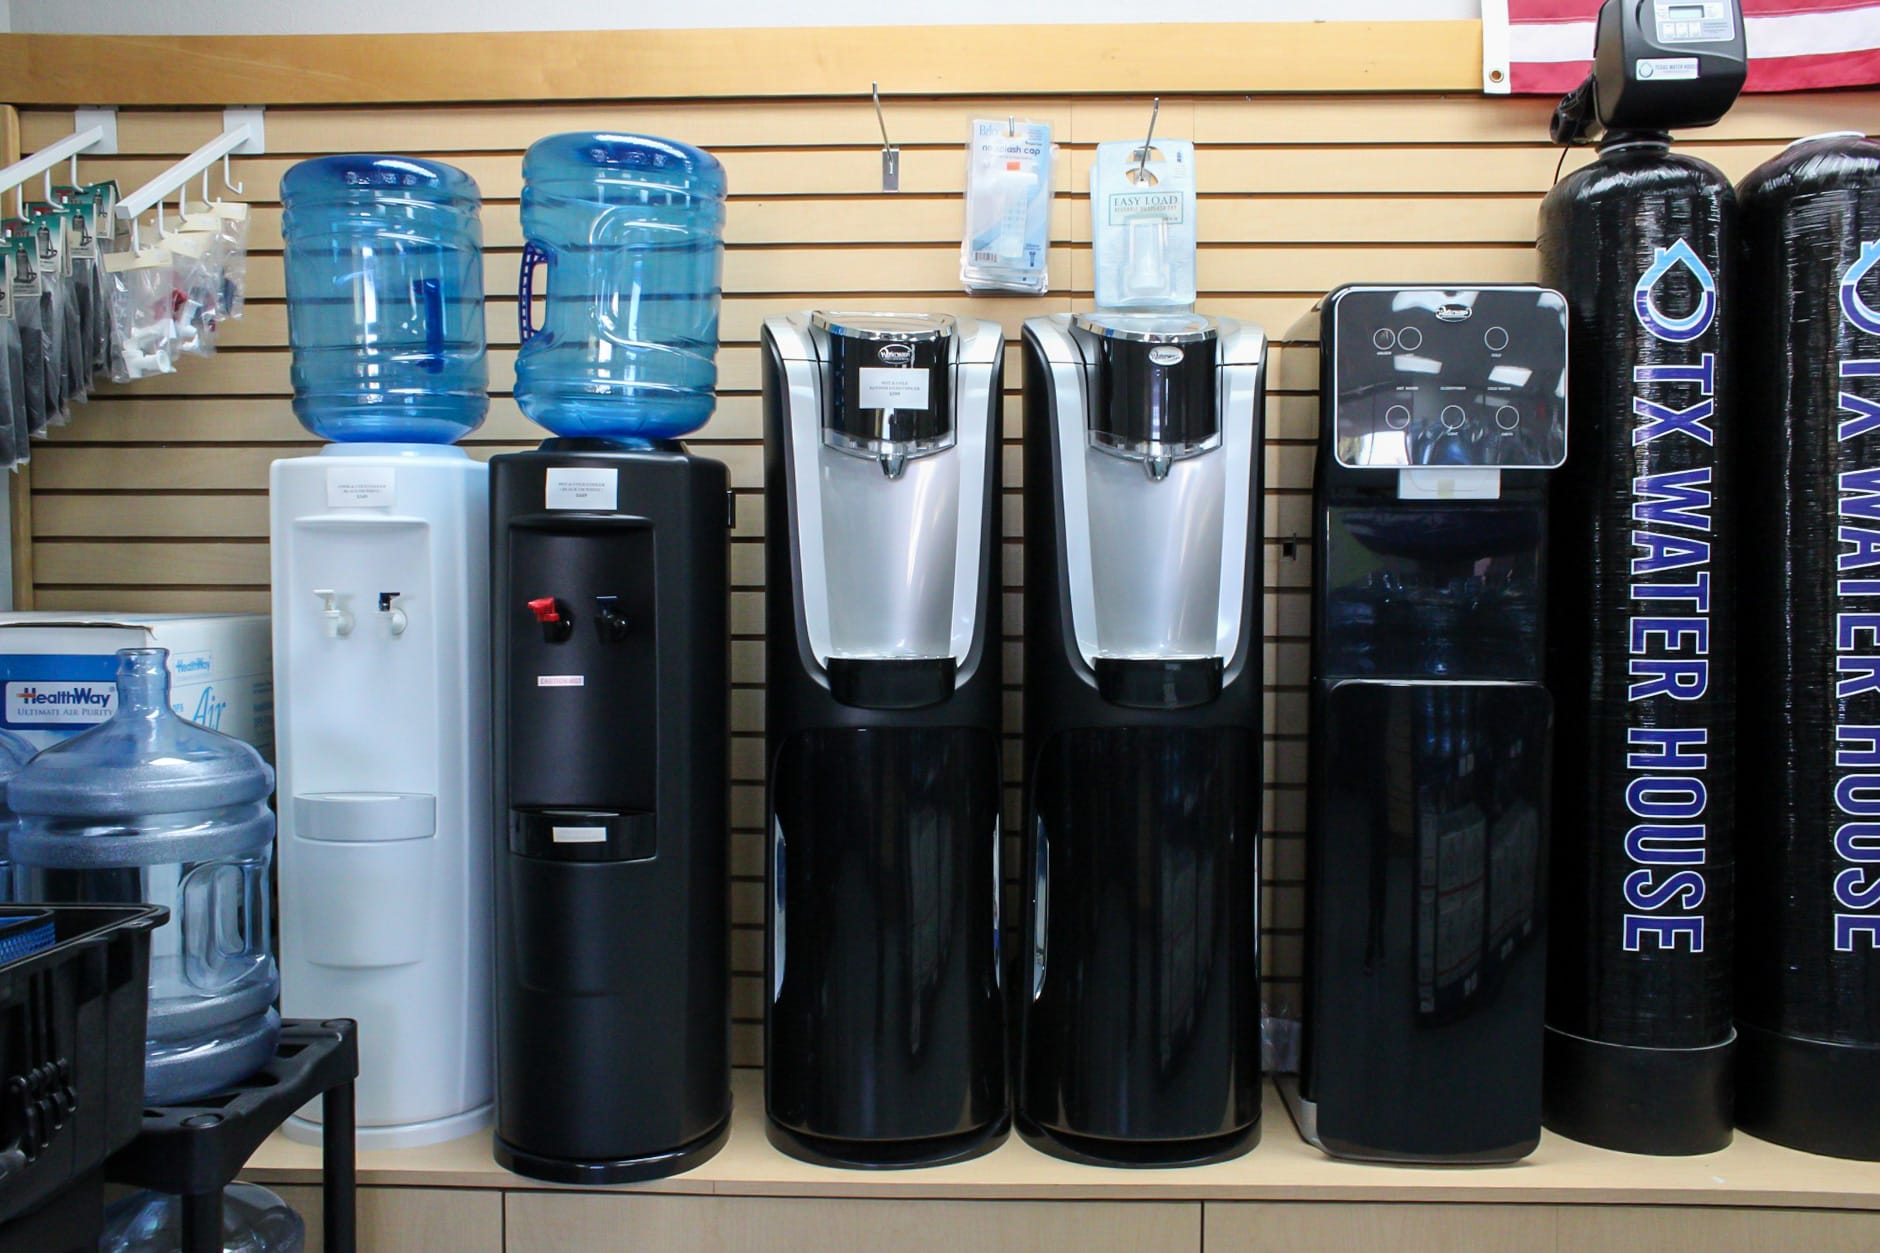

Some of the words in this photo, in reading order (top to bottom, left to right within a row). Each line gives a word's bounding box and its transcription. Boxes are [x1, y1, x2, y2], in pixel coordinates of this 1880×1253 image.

[1023, 147, 1041, 156] cap
[1113, 197, 1140, 206] EASY
[1145, 195, 1178, 205] LOAD
[1632, 353, 1715, 447] TX
[1628, 467, 1712, 702] WATER
[16, 687, 112, 708] HealthWay
[17, 708, 60, 717] ULTIMATE
[63, 708, 79, 717] AIR
[81, 708, 113, 717] PURITY
[192, 686, 227, 731] Air
[1623, 728, 1708, 953] HOUSE
